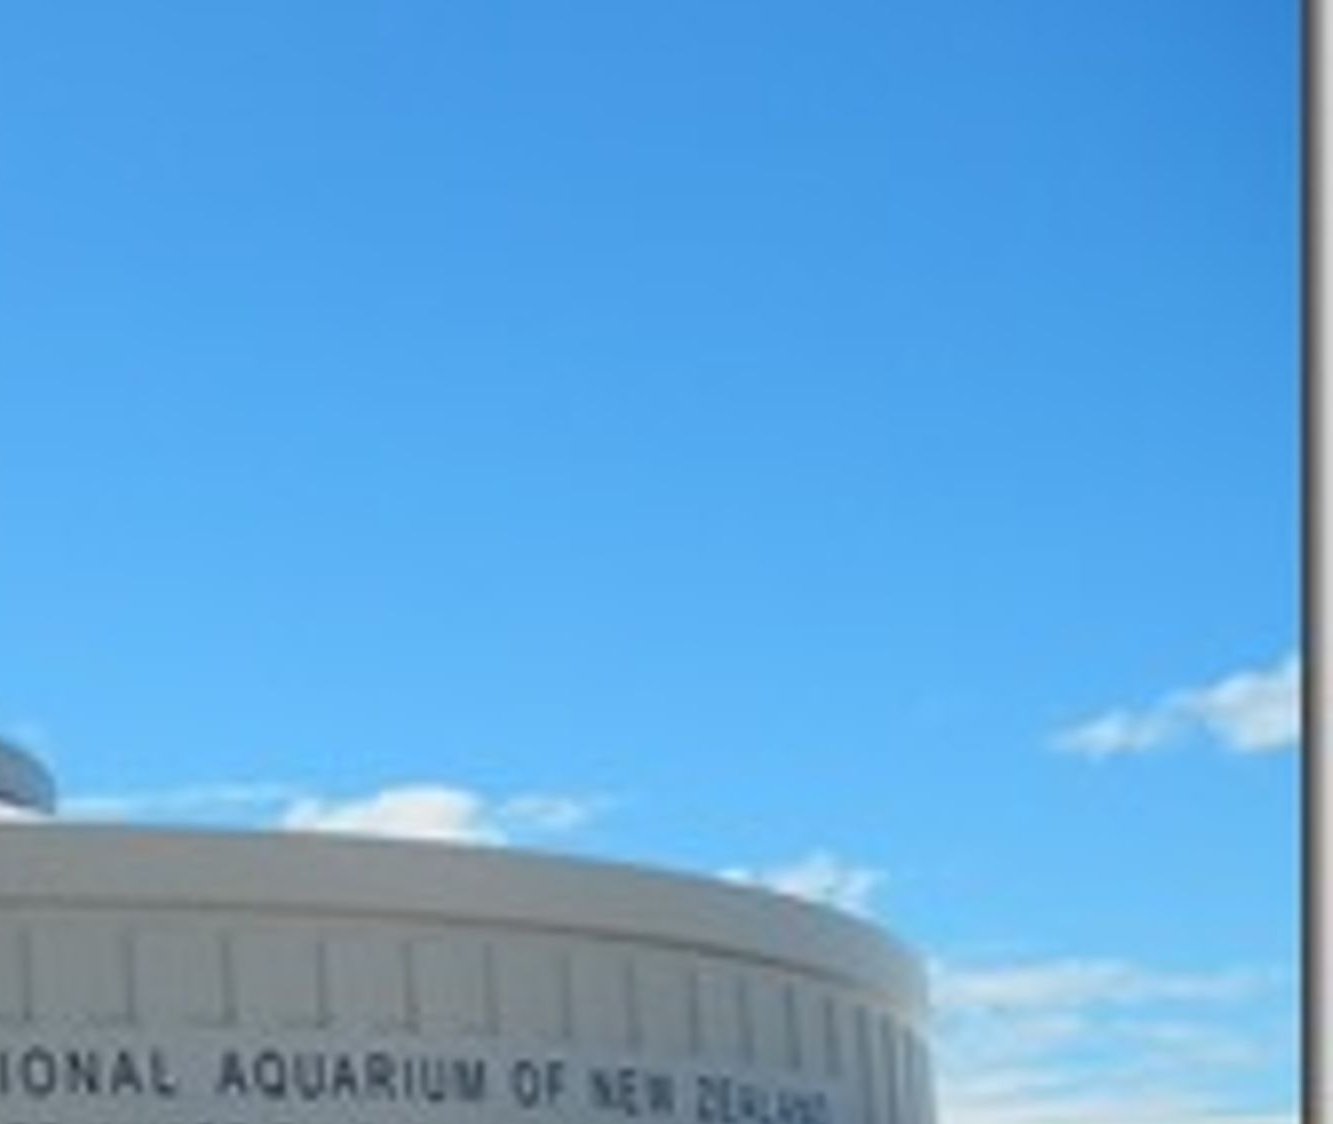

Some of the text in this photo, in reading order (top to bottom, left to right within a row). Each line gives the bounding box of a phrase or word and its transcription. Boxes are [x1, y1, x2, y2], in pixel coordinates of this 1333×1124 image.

[215, 1049, 486, 1102] AQUARIUM
[511, 1059, 566, 1109] OF
[591, 1066, 673, 1118] NEW
